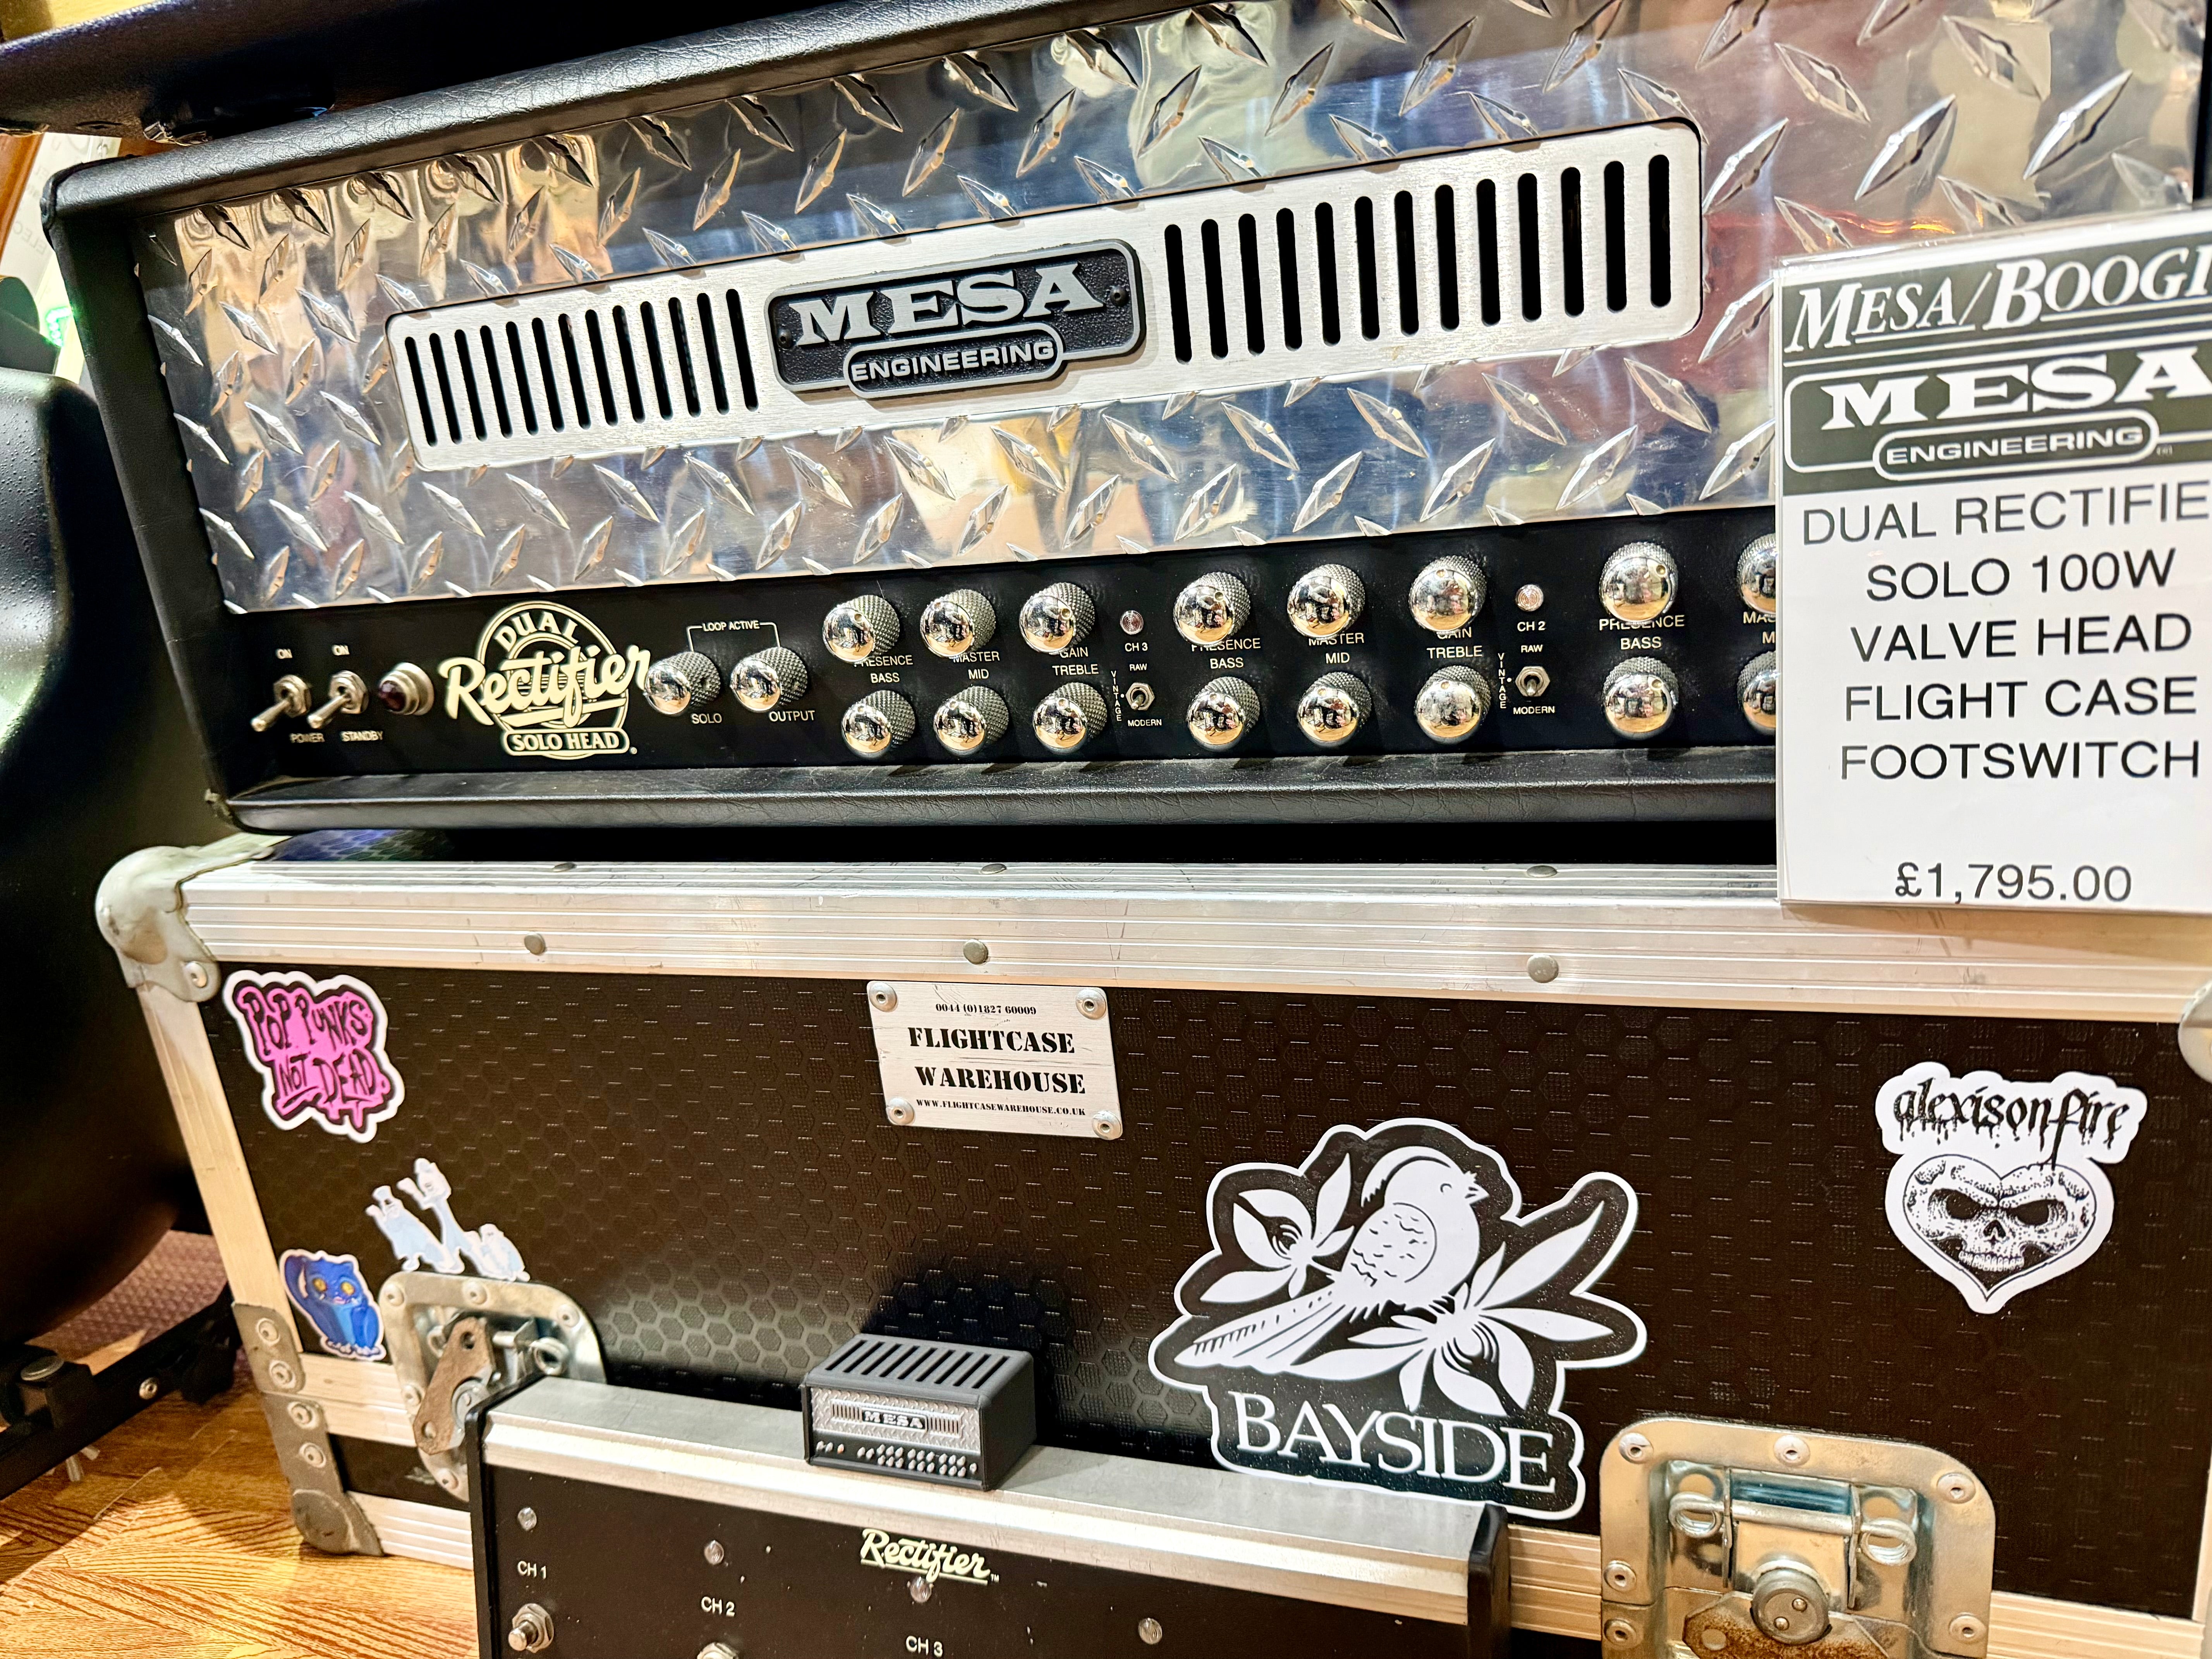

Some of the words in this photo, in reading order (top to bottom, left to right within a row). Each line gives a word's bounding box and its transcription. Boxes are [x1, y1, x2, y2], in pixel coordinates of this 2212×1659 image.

[789, 261, 1106, 346] MESA
[852, 340, 1054, 381] ENGINEERING
[1821, 347, 2212, 430] MESA
[1887, 427, 2143, 464] ENGINEERING
[1804, 501, 1936, 544] DUAL
[1867, 558, 2009, 601] SOLO
[2032, 548, 2175, 593] 100W
[494, 611, 582, 653] DUAL
[702, 622, 726, 632] LOOP
[729, 620, 759, 630] ACTIVE
[1517, 622, 1535, 632] CH
[1538, 621, 1546, 630] 2
[1621, 636, 1662, 650] BASS
[1851, 620, 2016, 662] VALVE
[2038, 613, 2191, 655] HEAD
[276, 649, 293, 659] ON
[332, 644, 350, 656] ON
[1060, 647, 1089, 658] GAIN
[1125, 643, 1140, 652] CH
[1142, 642, 1148, 651] 3
[1426, 645, 1482, 659] TREBLE
[1521, 644, 1542, 653] RAW
[854, 655, 913, 667] ESENCE
[1210, 657, 1244, 669] BASS
[1326, 652, 1350, 664] MID
[871, 672, 900, 683] BASS
[968, 669, 989, 679] MID
[1052, 664, 1099, 676] TREBLE
[438, 646, 651, 727] Rectifier
[1498, 653, 1506, 709] VINTAGE
[1111, 670, 1122, 721] VINTAGE
[1846, 682, 2027, 721] FLIGHT
[2045, 677, 2197, 716] CASE
[691, 713, 722, 724] SOLO
[769, 710, 815, 722] OUTPUT
[1513, 706, 1555, 715] MODERN
[1128, 719, 1162, 727] MODERN
[290, 732, 325, 743] POWER
[341, 730, 383, 741] STANDBY
[512, 733, 563, 751] SOLO
[566, 732, 619, 749] HEAD
[1841, 740, 2198, 780] FOOTSWITCH
[1895, 862, 2131, 904] £1,795.00
[936, 1003, 960, 1013] 0044
[963, 1004, 1001, 1014] (0)1827
[1005, 1006, 1037, 1015] 60009
[242, 991, 292, 1056] POP
[908, 1027, 1075, 1054] FLIGHTCASE
[279, 1050, 311, 1097] NOT
[914, 1066, 1085, 1094] WAREHOUSE
[916, 1099, 1086, 1116] WWW.FLIGHTCASEWAREHOUSE.CO.UK
[1893, 1078, 2131, 1170] alexisonfire
[864, 1411, 923, 1428] MESA
[1228, 1391, 1555, 1493] BAYSIDE
[860, 1528, 990, 1582] Rectifier
[517, 1561, 537, 1577] CH
[540, 1566, 547, 1579] 1
[701, 1596, 723, 1614] CH
[726, 1601, 735, 1617] 2
[906, 1635, 929, 1654] CH
[934, 1641, 943, 1657] 3
